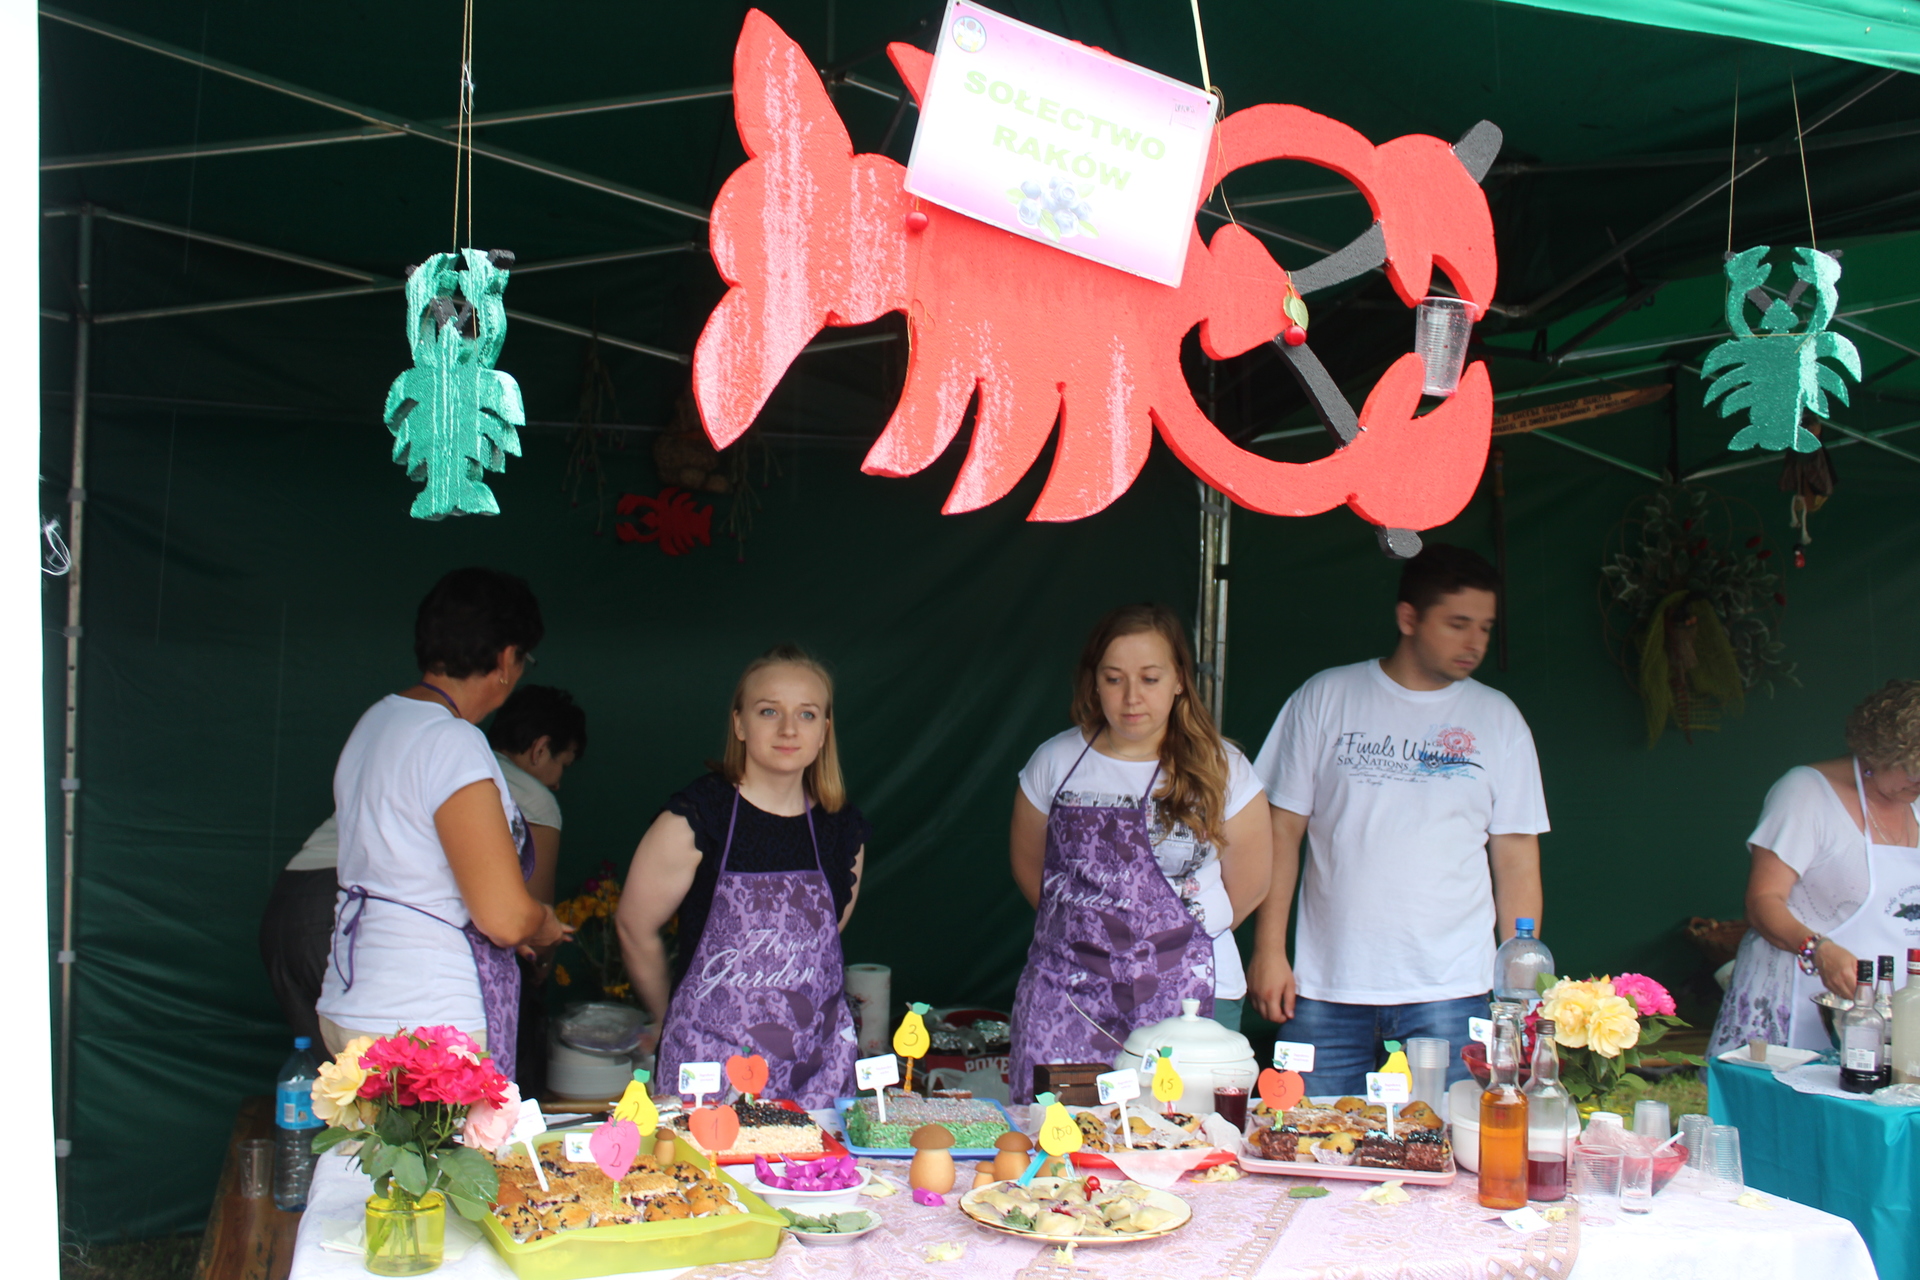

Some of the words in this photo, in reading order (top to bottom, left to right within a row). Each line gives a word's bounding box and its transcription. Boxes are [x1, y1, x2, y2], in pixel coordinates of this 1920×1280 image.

[963, 70, 1166, 161] SOŁECTWO
[992, 124, 1132, 191] RAKÓW
[1343, 731, 1395, 758] Finals
[1064, 858, 1131, 882] Flower
[1043, 872, 1132, 916] Garden
[745, 928, 819, 956] Flower
[694, 948, 816, 1000] Garden
[903, 1024, 919, 1047] 3
[741, 1066, 753, 1081] 3
[1160, 1078, 1174, 1094] 1,5
[1272, 1079, 1287, 1098] 3
[711, 1120, 718, 1140] 1
[609, 1143, 622, 1169] 2
